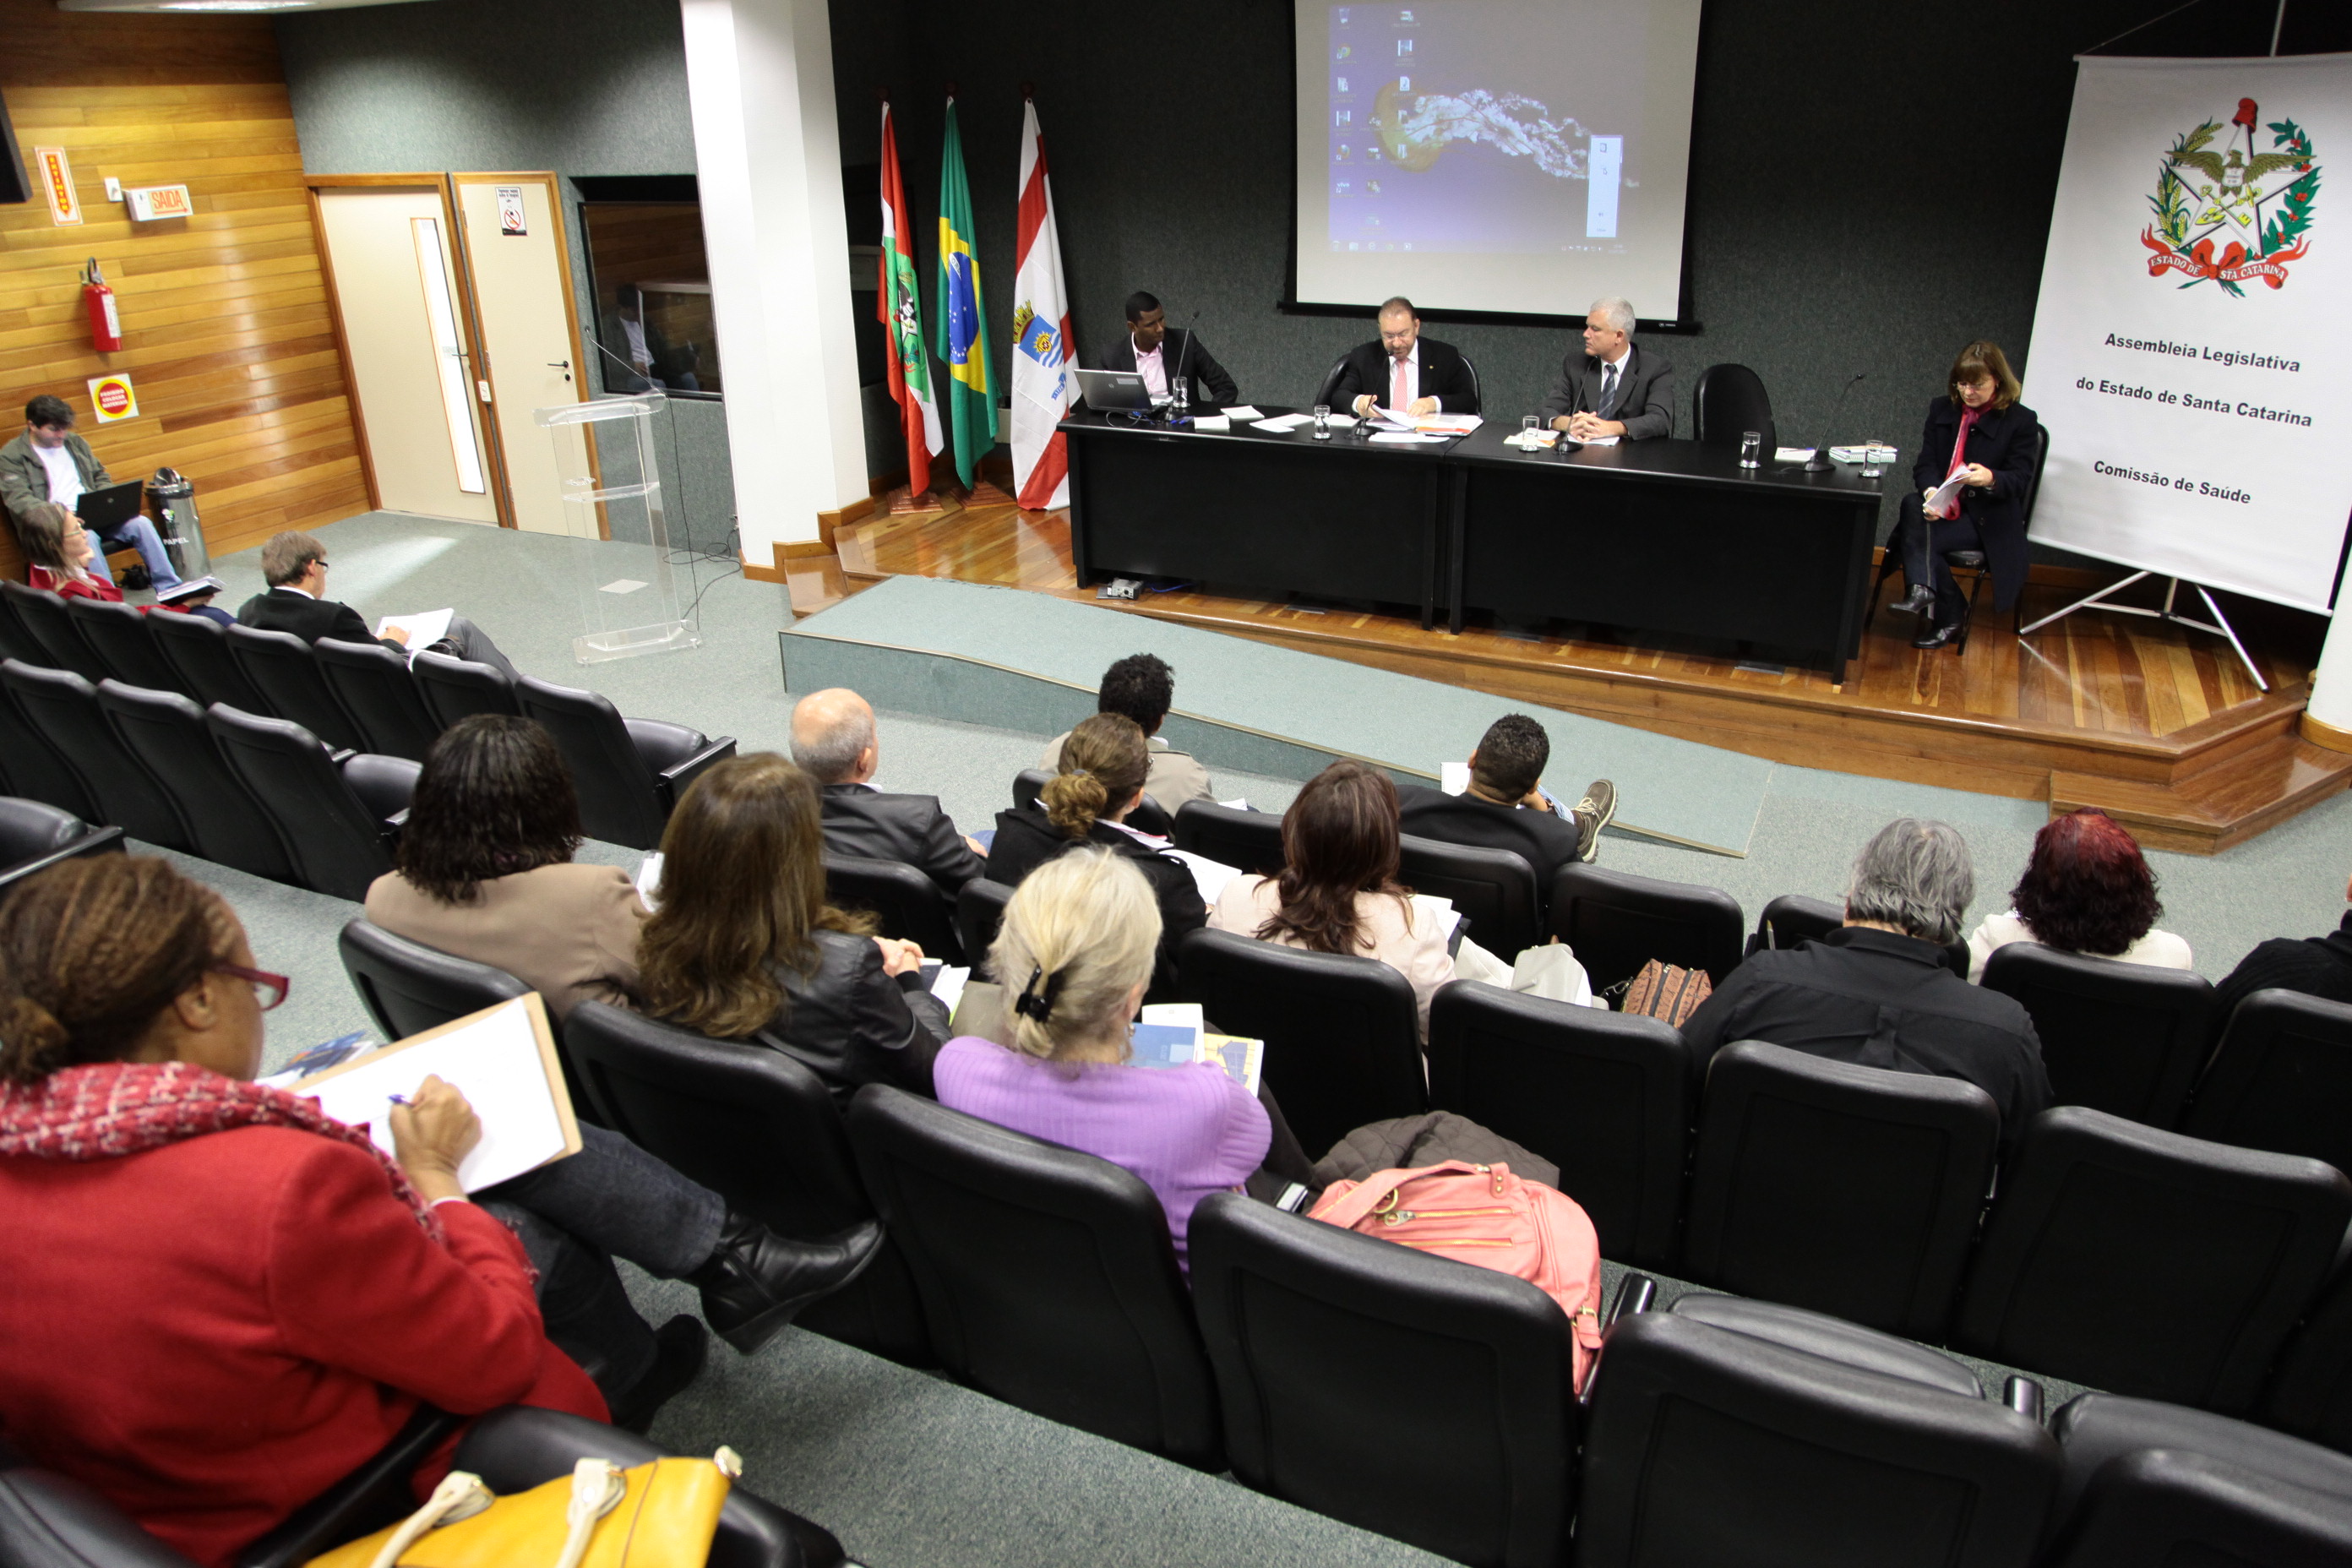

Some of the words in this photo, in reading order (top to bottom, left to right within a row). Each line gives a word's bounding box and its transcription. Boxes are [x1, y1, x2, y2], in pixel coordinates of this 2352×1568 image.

[2151, 255, 2186, 270] ESTADO
[2186, 262, 2200, 275] DE
[2240, 264, 2285, 280] CATARINA
[2104, 333, 2197, 358] Assembleia
[2202, 346, 2300, 372] Legislativa
[2076, 377, 2094, 390] do
[2099, 380, 2153, 400] Estado
[2158, 390, 2177, 404] de
[2182, 394, 2231, 413] Santa
[2236, 402, 2312, 427] Catarina
[2093, 460, 2170, 487] Comissão
[2174, 477, 2194, 492] de
[2199, 482, 2251, 504] Saúde
